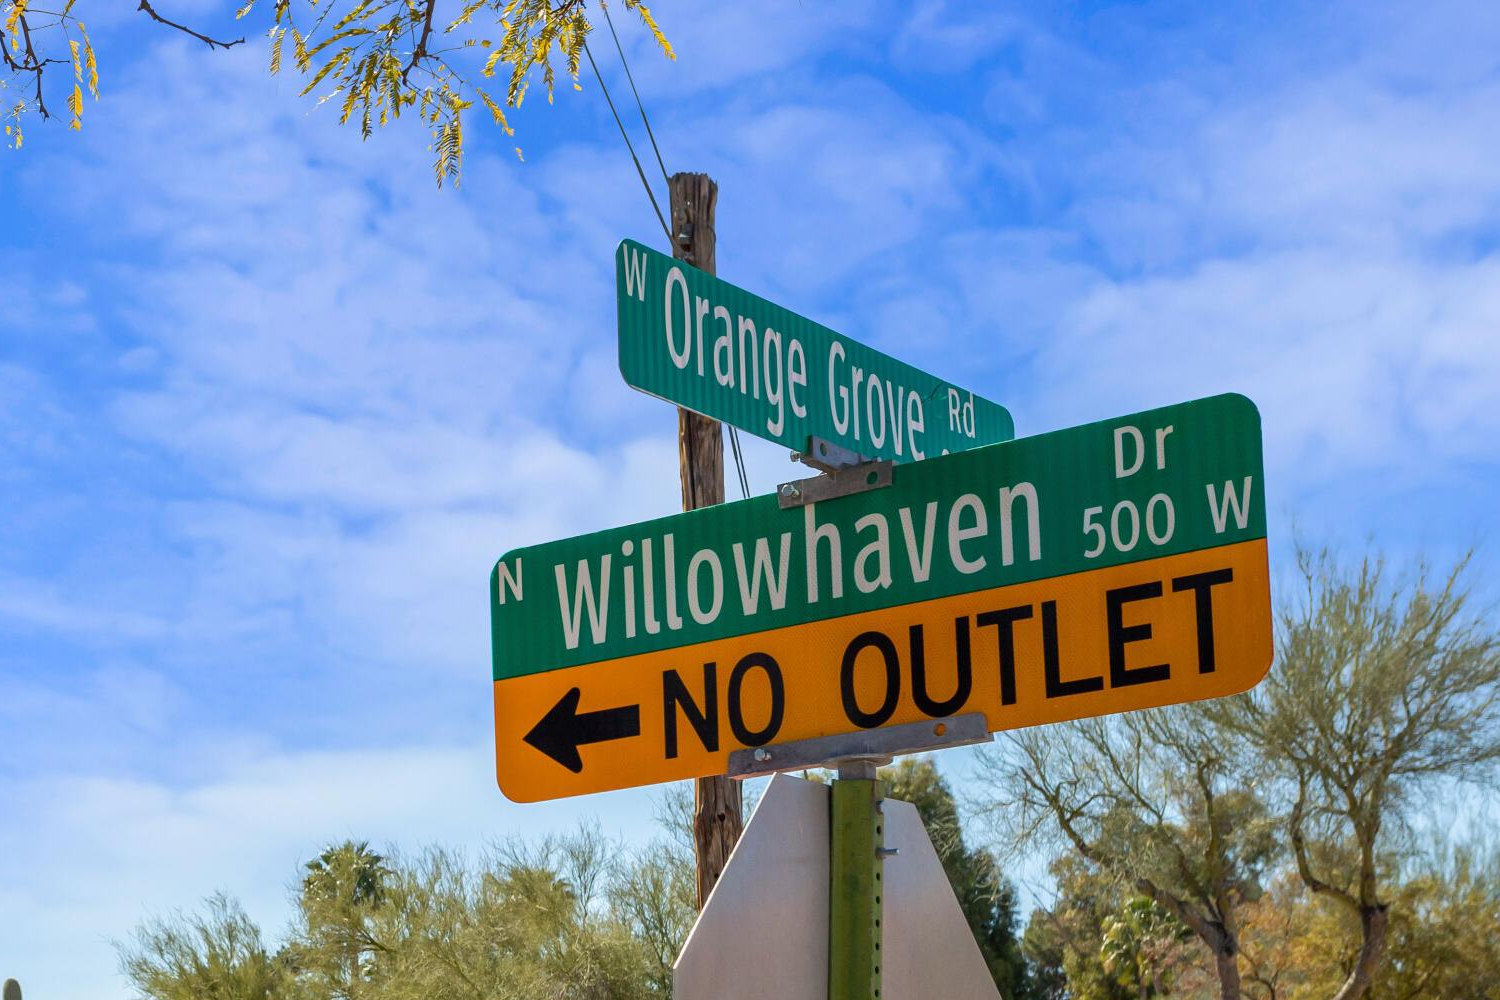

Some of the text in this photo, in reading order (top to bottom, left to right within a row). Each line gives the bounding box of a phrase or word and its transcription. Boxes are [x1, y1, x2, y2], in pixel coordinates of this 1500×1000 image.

[622, 243, 976, 462] W Orange Grove Rd
[1114, 423, 1174, 480] Dr
[499, 475, 1253, 651] N Willowhaven 500 W
[662, 568, 1234, 760] NO OUTLET
